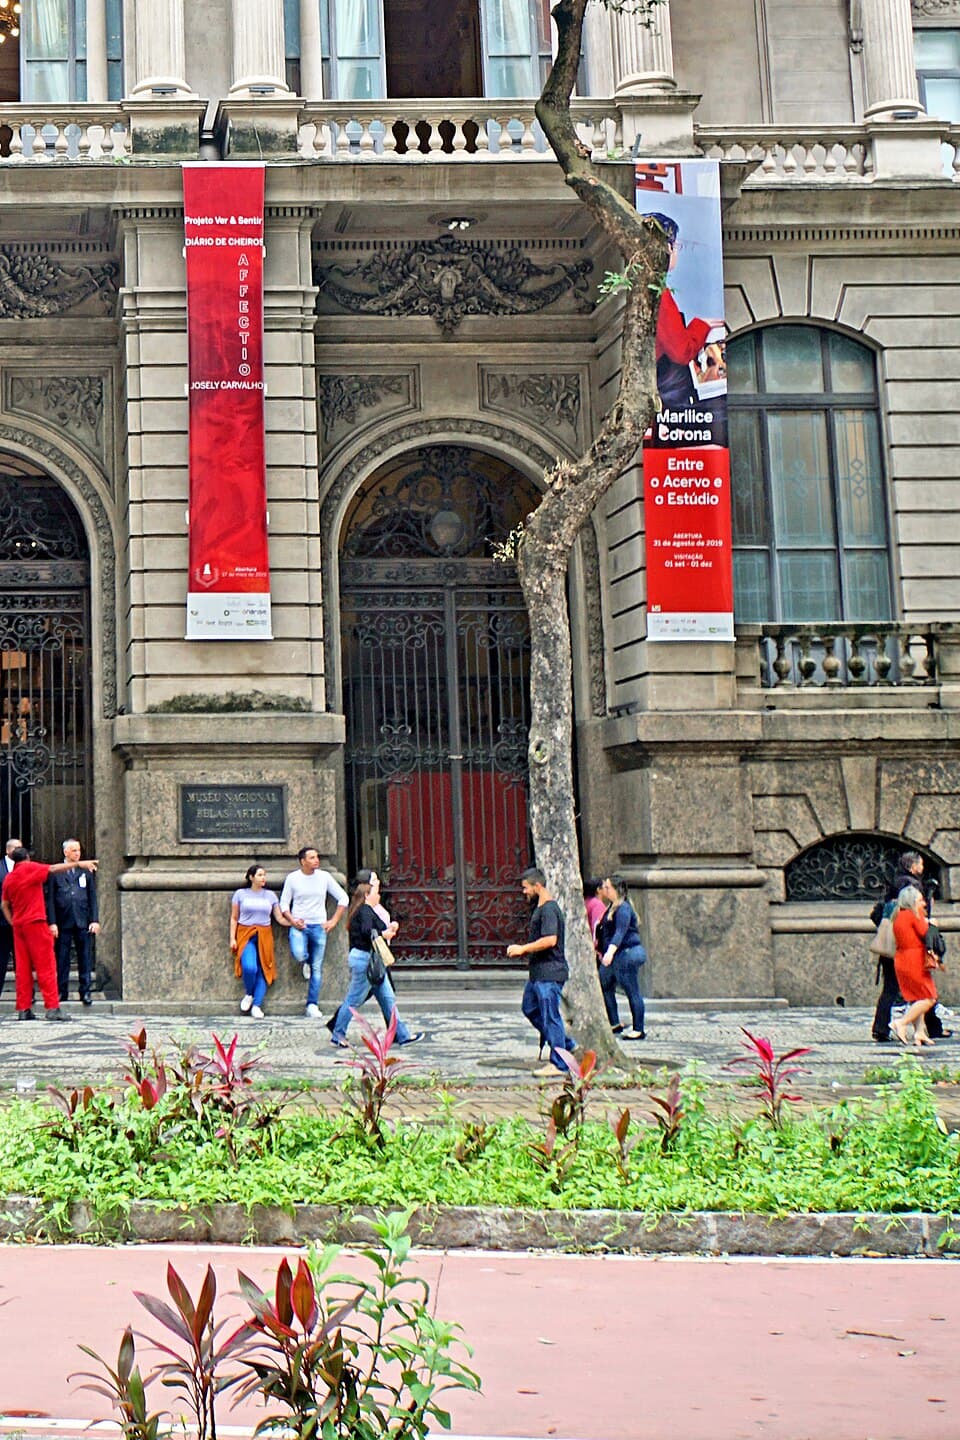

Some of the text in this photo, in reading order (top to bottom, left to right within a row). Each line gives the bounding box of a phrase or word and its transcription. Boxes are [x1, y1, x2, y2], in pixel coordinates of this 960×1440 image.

[184, 215, 214, 227] Projeto
[214, 215, 228, 225] Ver
[238, 215, 263, 225] Sentir
[185, 235, 264, 247] DIÁRIO DE CHEIROS
[190, 380, 264, 390] JOSELY CARVALHO
[656, 408, 713, 424] Marilice
[658, 426, 712, 441] Corona
[667, 457, 704, 471] Entre
[650, 474, 723, 488] o Acervo e
[654, 491, 719, 505] o Estúdio
[186, 792, 279, 803] MUSEU NACIONAL
[196, 808, 270, 819] BELAS ARTES
